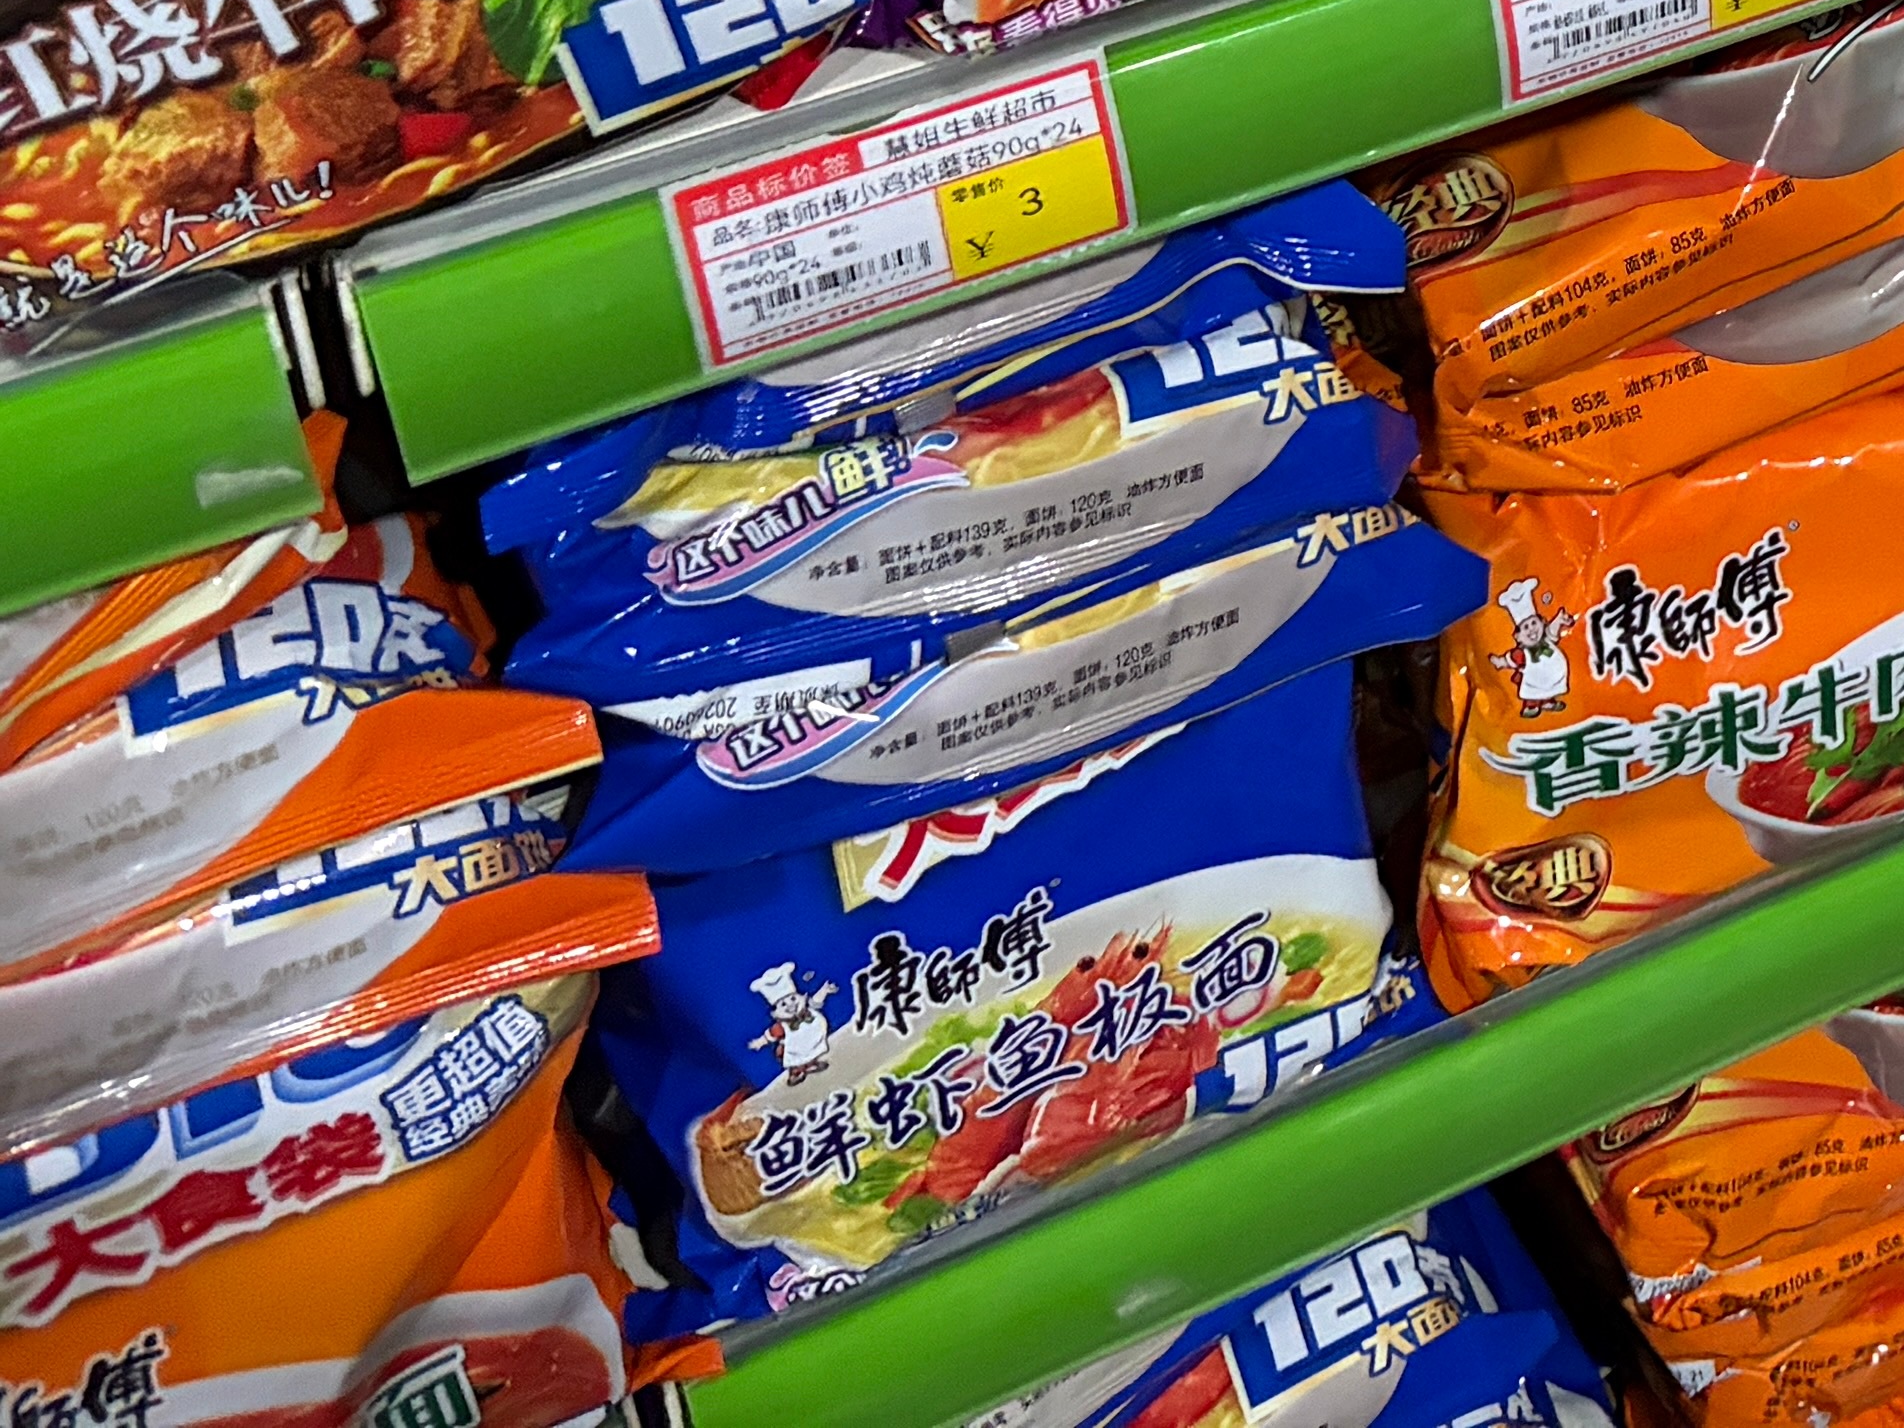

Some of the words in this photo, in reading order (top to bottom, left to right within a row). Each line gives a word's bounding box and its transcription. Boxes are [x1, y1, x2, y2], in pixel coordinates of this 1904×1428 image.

[687, 152, 851, 222] 商品标价签
[951, 178, 1005, 205] 零售价
[1019, 187, 1044, 217] 3
[965, 231, 995, 261] ¥
[1624, 354, 1710, 398] 油炸方便面
[1125, 460, 1207, 499] 油炸方便面
[1166, 607, 1242, 650] 油炸方便面
[1587, 527, 1793, 691] 康師傅
[852, 887, 1052, 1034] 康師傅
[387, 998, 544, 1122] 更超值
[748, 908, 1281, 1196] 鲜虾鱼板面
[6, 1108, 390, 1314] 大食袋
